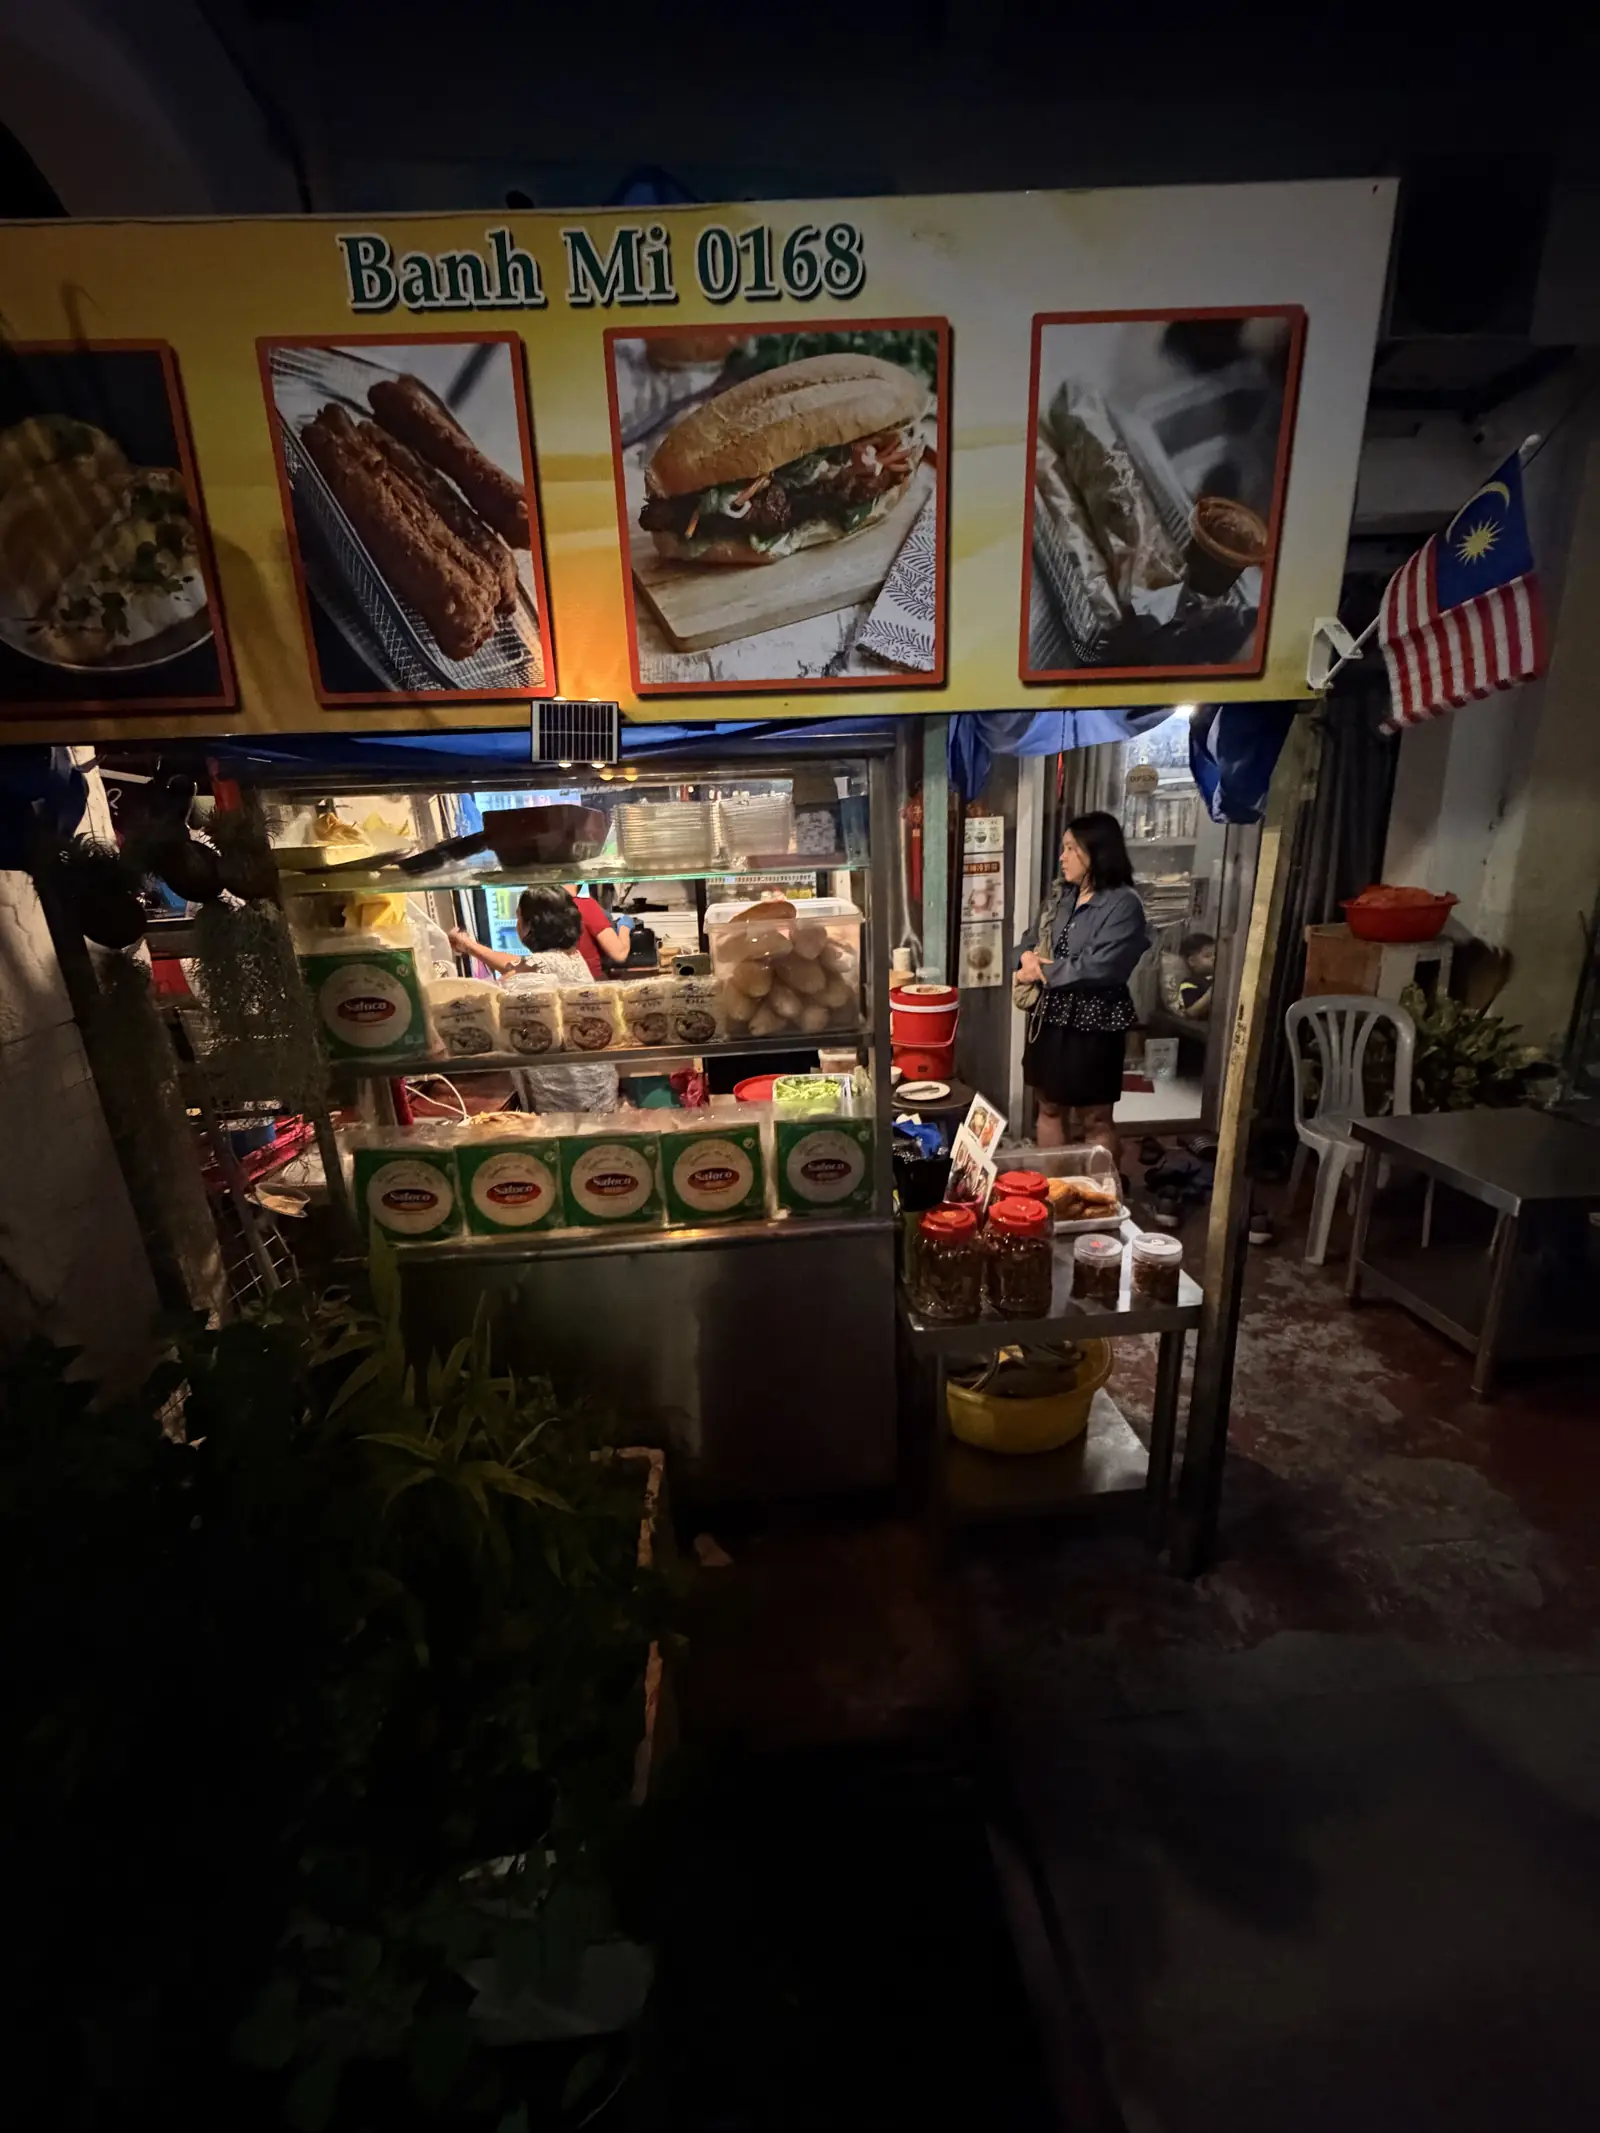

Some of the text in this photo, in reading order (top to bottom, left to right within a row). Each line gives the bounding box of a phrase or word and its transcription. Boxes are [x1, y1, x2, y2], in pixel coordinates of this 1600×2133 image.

[337, 221, 867, 311] Banh Mi 0168
